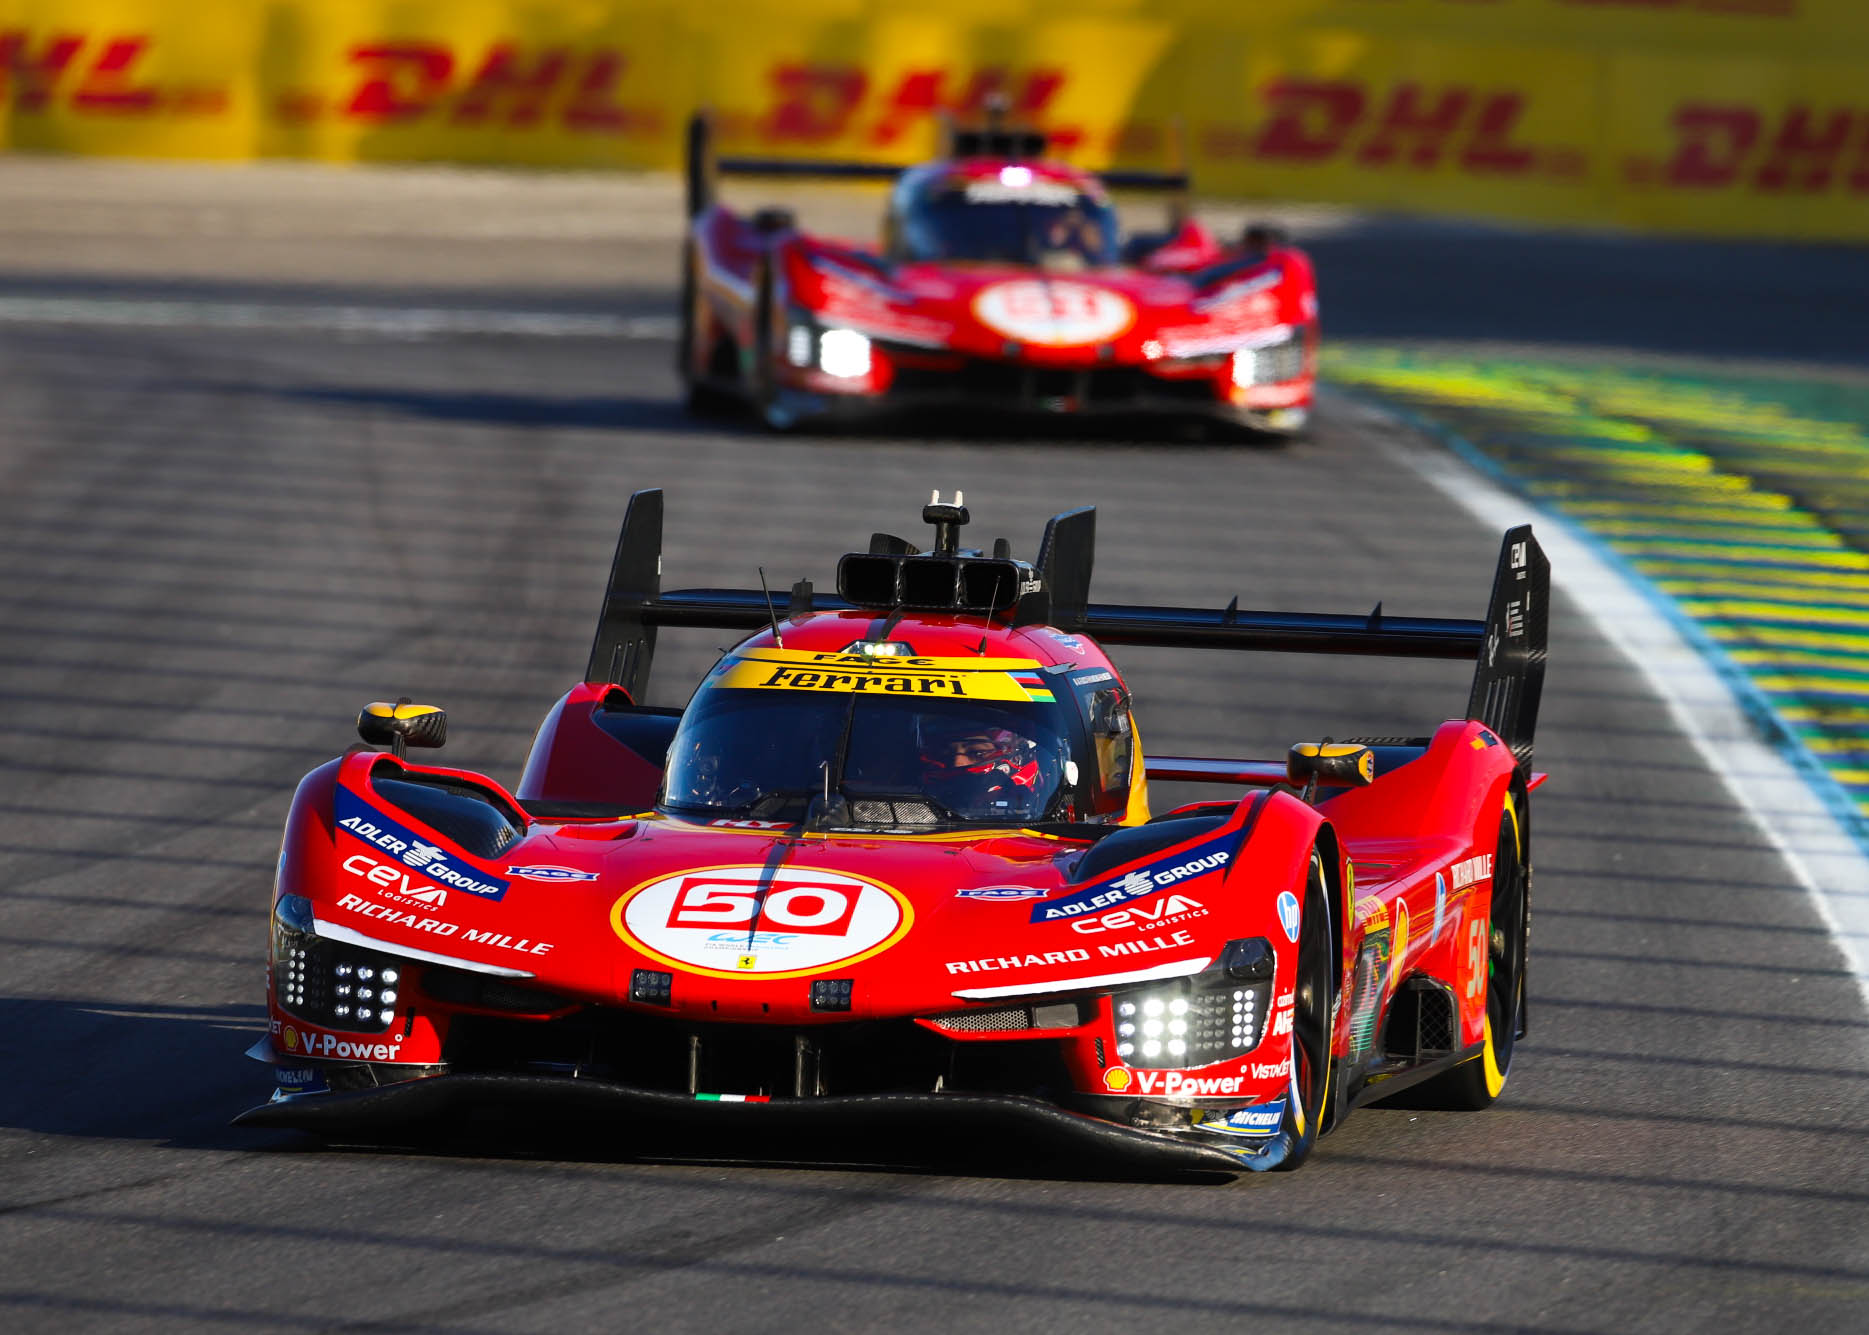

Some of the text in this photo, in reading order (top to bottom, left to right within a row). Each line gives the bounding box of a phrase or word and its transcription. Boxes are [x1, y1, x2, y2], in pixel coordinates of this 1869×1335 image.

[0, 34, 156, 116] HL
[343, 42, 628, 134] DHL
[1255, 76, 1535, 174] DHL
[1662, 104, 1869, 192] DH
[759, 666, 968, 696] Ferrari
[339, 816, 499, 894] ADLER GROUP
[377, 889, 439, 912] LOGISTICS
[676, 884, 848, 927] 50
[1045, 851, 1230, 919] ADLER GROUP
[336, 893, 555, 957] RICHARD MILLE
[1138, 908, 1210, 932] LOGISTICS
[1282, 893, 1298, 940] hp
[945, 929, 1196, 975] RICHARD MILLE
[1467, 919, 1486, 997] 50
[300, 1031, 401, 1061] V-Power
[1136, 1071, 1244, 1095] V-Power
[1229, 1111, 1280, 1126] MICHELIN
